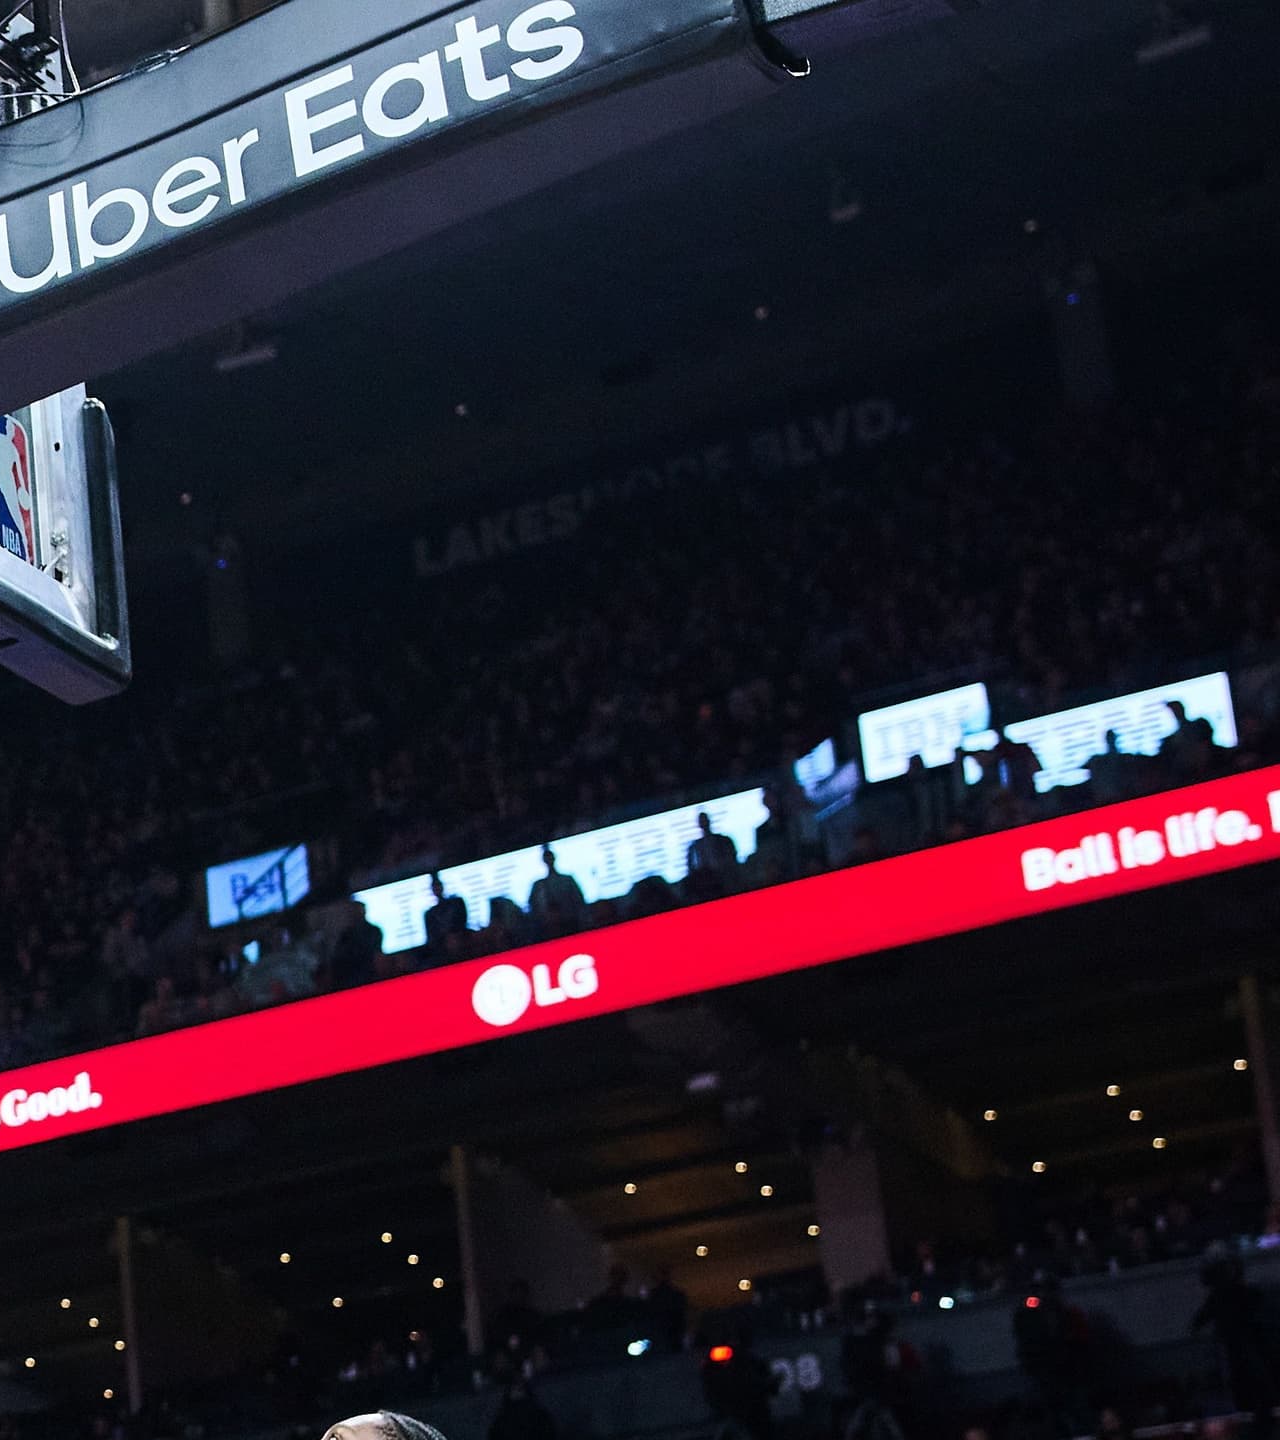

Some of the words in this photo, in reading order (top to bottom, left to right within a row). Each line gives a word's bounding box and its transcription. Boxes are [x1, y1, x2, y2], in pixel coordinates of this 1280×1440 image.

[284, 0, 585, 178] Eats
[1, 523, 22, 557] NBA
[1021, 832, 1119, 892] Ball
[1117, 825, 1167, 870] is
[1164, 806, 1263, 859] life.
[531, 953, 599, 1008] LG
[0, 1071, 103, 1127] Good.
